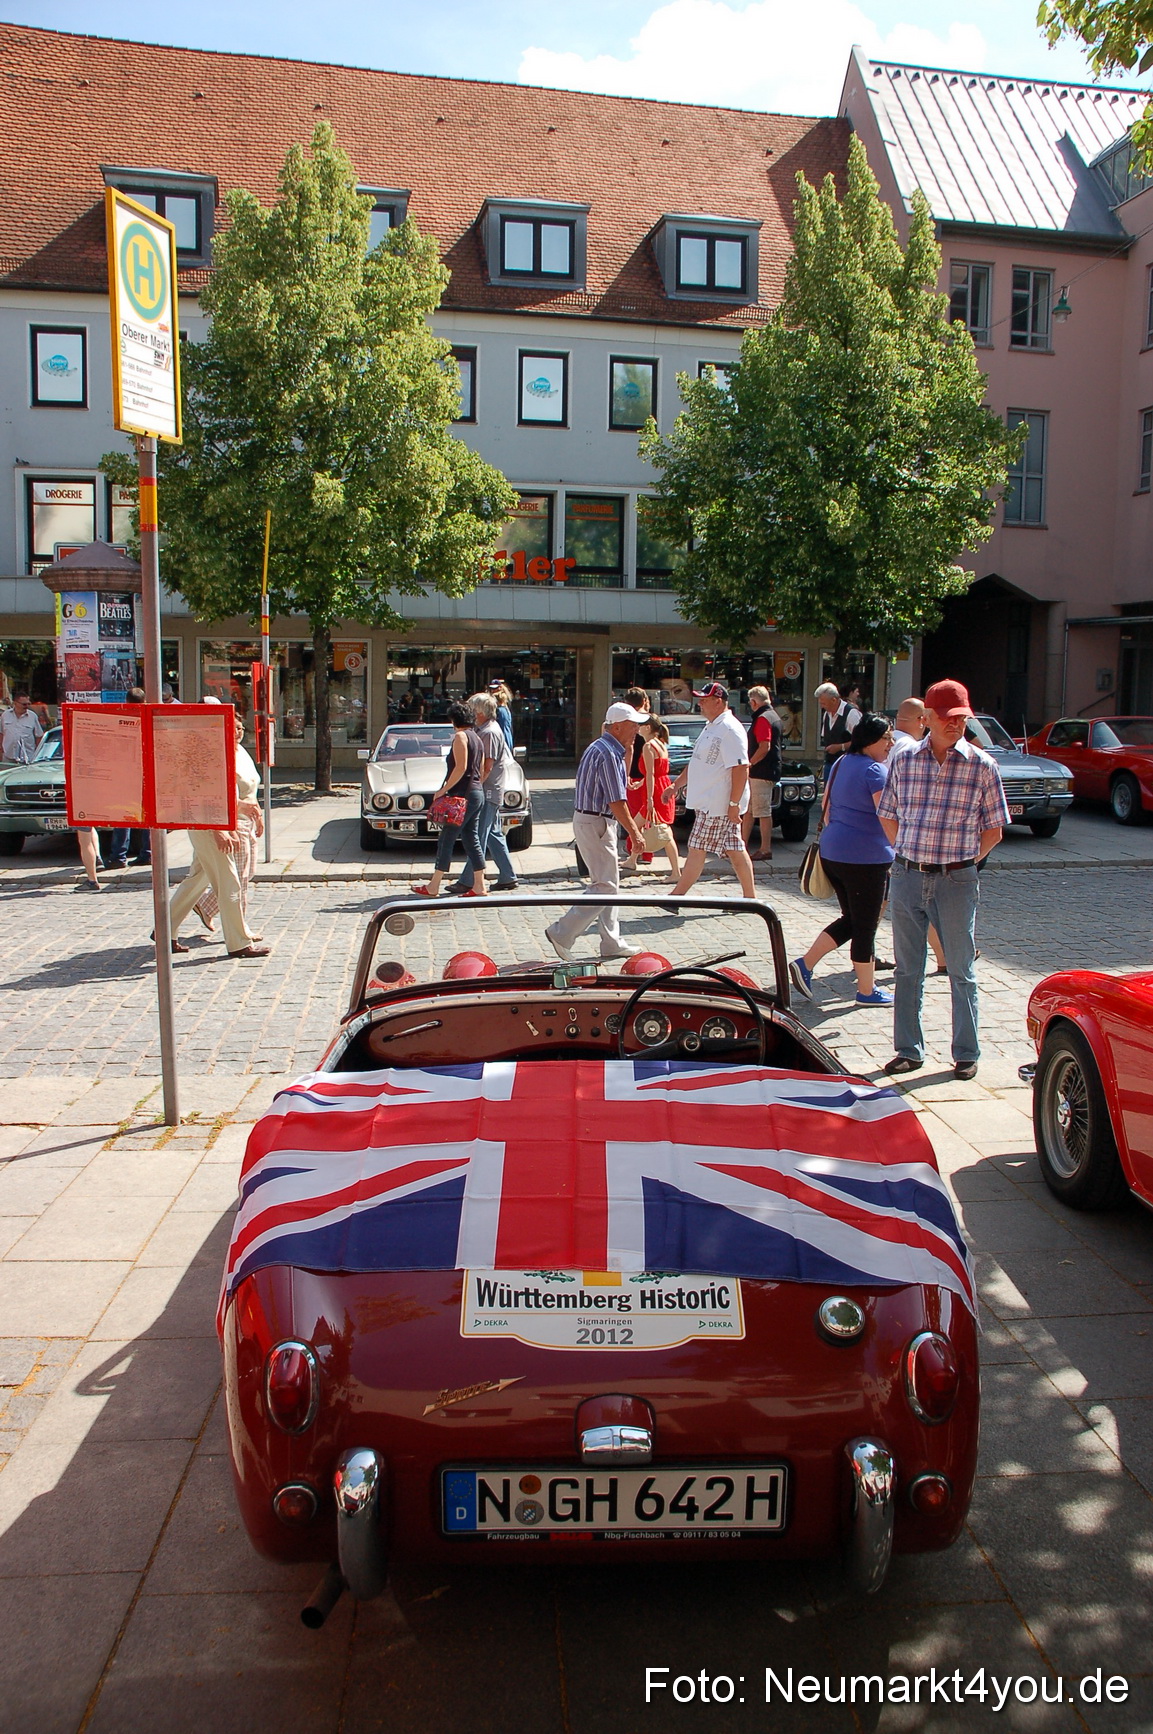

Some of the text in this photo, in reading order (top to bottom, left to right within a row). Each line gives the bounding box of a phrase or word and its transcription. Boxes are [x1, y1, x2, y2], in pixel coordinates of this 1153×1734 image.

[132, 242, 156, 301] H
[122, 323, 148, 344] Oberer
[150, 334, 171, 353] Markt
[45, 489, 82, 499] DROGERIE
[100, 602, 132, 619] BEATLES
[476, 1277, 632, 1312] Württemberg
[577, 1317, 633, 1326] Sigmaringen
[576, 1328, 634, 1345] 2012
[478, 1478, 511, 1523] N
[548, 1476, 618, 1523] GH
[456, 1507, 467, 1520] D
[487, 1533, 540, 1541] Fahrzeugbau
[604, 1532, 665, 1540] Nbg-Fischbach
[731, 1530, 741, 1538] 04
